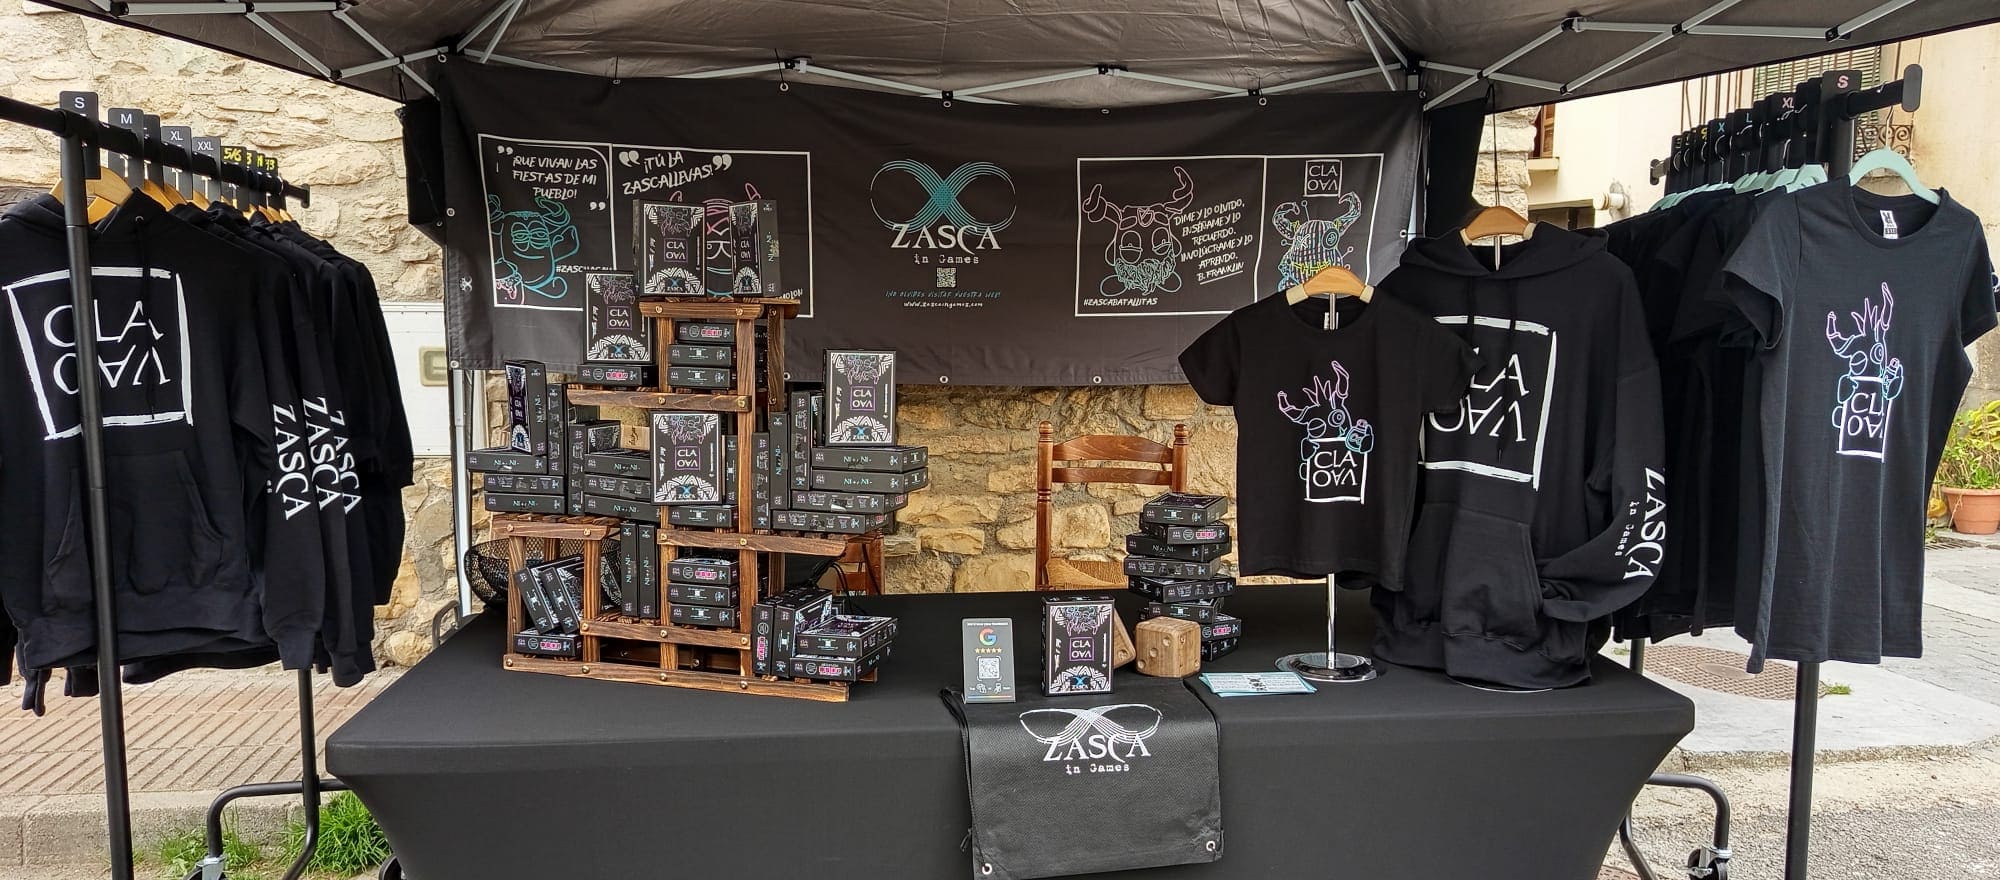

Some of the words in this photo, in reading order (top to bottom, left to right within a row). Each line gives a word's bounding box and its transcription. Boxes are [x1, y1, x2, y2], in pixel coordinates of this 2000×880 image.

[1837, 75, 1849, 89] S
[74, 96, 85, 109] S
[120, 113, 133, 125] M
[170, 130, 183, 141] XL
[197, 141, 214, 151] XXL
[223, 147, 242, 162] 5/6
[668, 150, 684, 168] LA
[537, 157, 573, 169] VIVAN
[574, 158, 599, 170] LAS
[1308, 164, 1338, 177] CLA
[512, 169, 563, 183] FIESTAS
[563, 173, 581, 185] DE
[581, 174, 597, 185] MI
[622, 163, 714, 195] ZASCALLEVAS!
[532, 186, 578, 200] PUEBLO!
[1173, 211, 1196, 226] DIME
[1204, 206, 1213, 219] LO
[1232, 212, 1241, 223] LO
[890, 223, 1002, 255] ZASCA
[1192, 227, 1237, 245] RECUERDO.
[1243, 234, 1253, 246] LO
[666, 241, 686, 249] CLA
[914, 253, 929, 265] in
[938, 254, 980, 264] Games
[1198, 251, 1239, 270] APRENDO.
[1206, 262, 1244, 277] FRANKLIN
[609, 308, 629, 317] CLA
[44, 299, 165, 348] CLA
[852, 389, 872, 398] CLA
[302, 396, 342, 511] ZASCA
[677, 449, 698, 457] CLA
[1313, 450, 1358, 469] CLA
[272, 403, 312, 521] ZASCA
[329, 409, 363, 515] ZASCA
[1623, 466, 1667, 580] ZASCA
[1072, 640, 1092, 648] CLA
[1043, 734, 1151, 763] ZASCA
[1065, 764, 1081, 775] in
